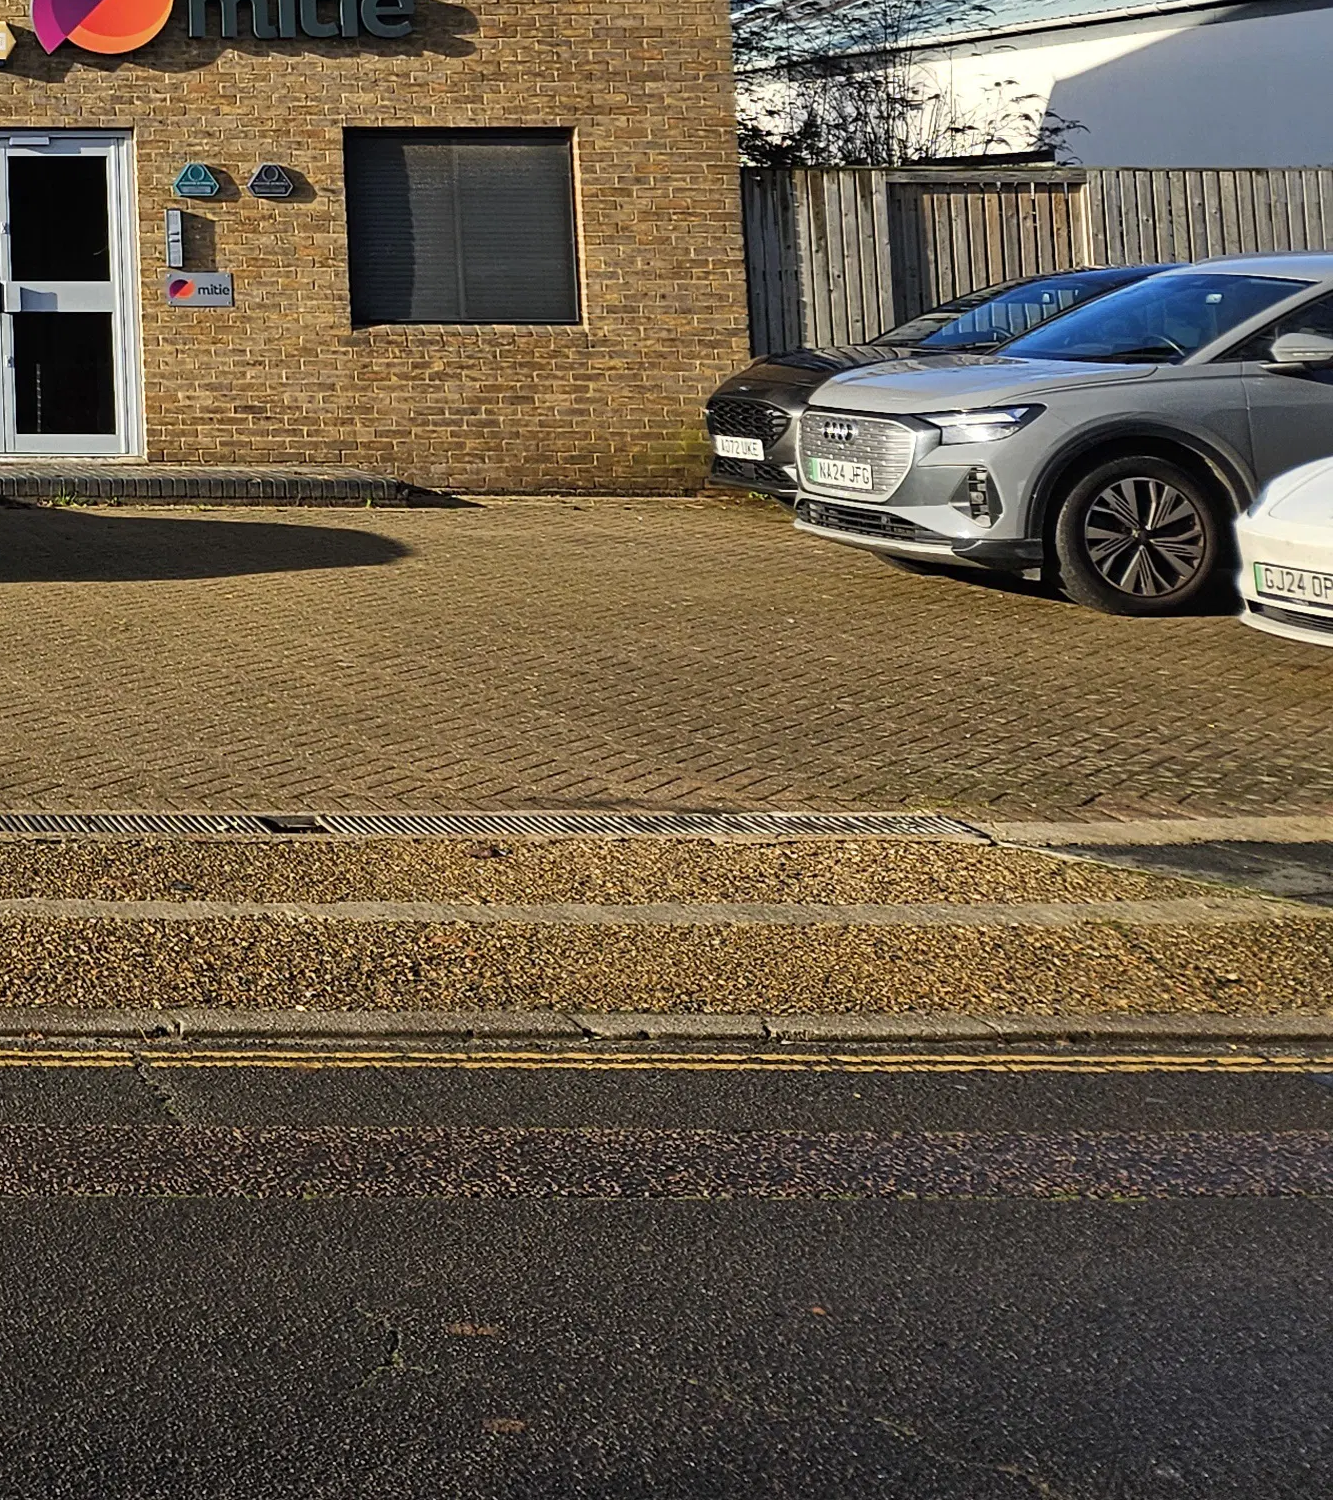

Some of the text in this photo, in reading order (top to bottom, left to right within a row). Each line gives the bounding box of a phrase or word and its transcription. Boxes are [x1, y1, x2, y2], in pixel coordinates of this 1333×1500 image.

[198, 284, 230, 295] mitie
[819, 461, 846, 483] NA24
[1264, 567, 1306, 595] GJ24
